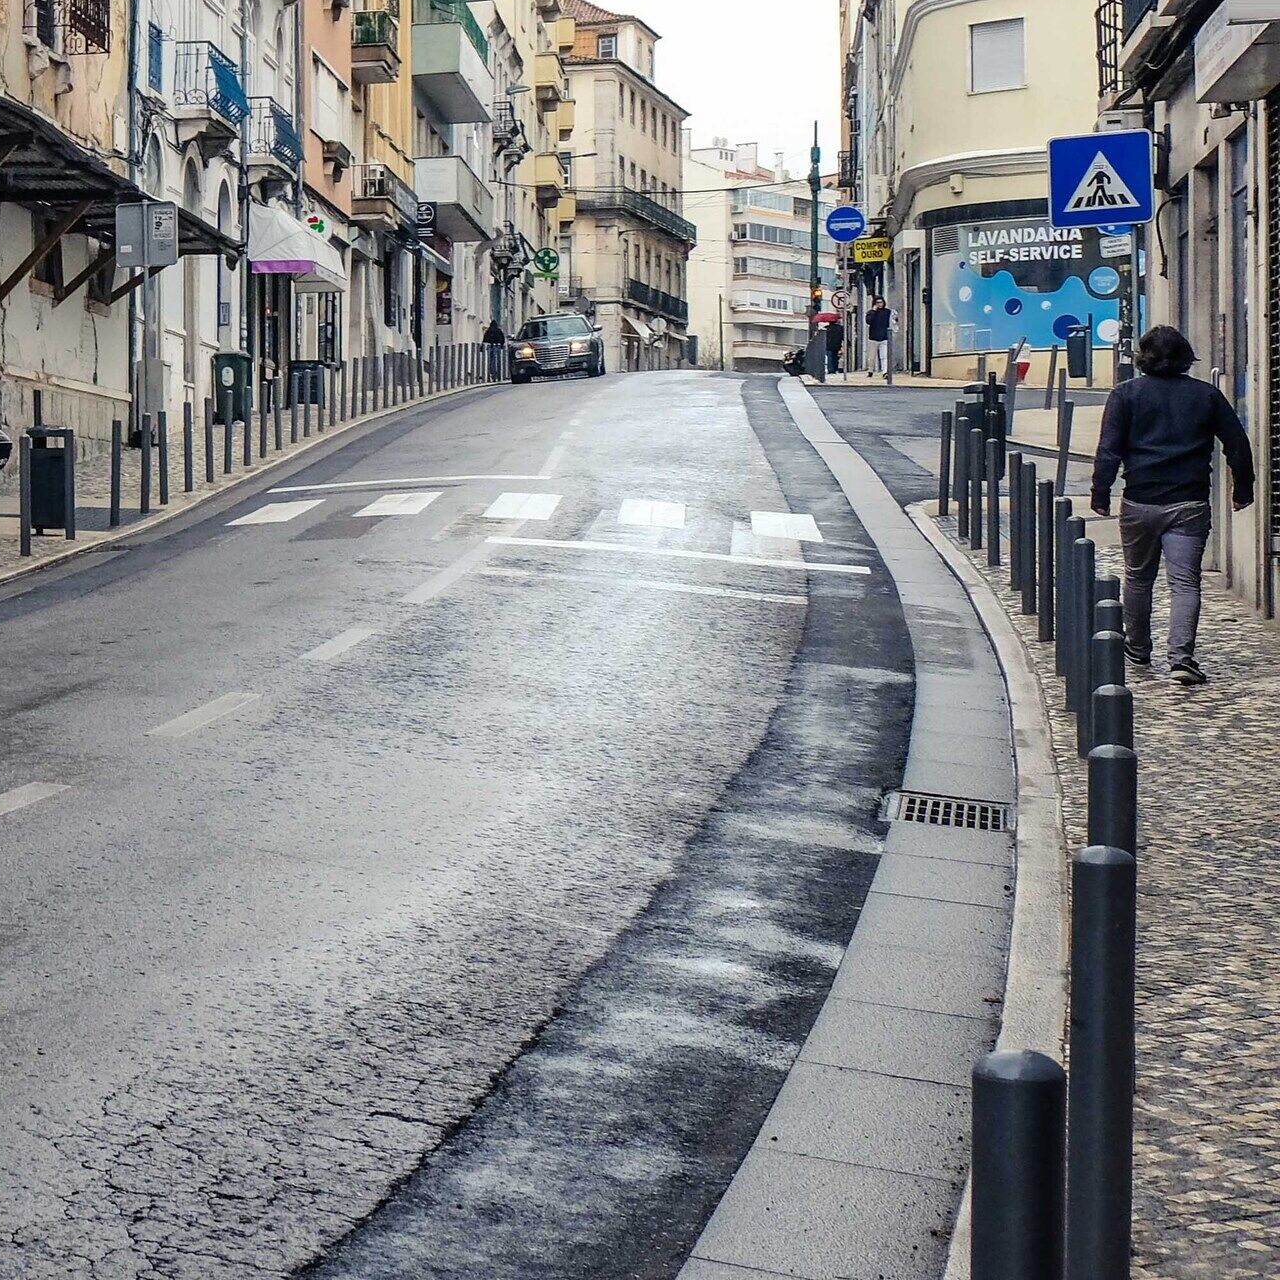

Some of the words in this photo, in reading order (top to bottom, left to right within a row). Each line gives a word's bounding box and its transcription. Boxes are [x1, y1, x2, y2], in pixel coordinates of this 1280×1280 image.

[855, 240, 889, 252] COMPRO
[967, 226, 1084, 248] LAVANDARIA
[968, 244, 1084, 266] SELF-SERVICE
